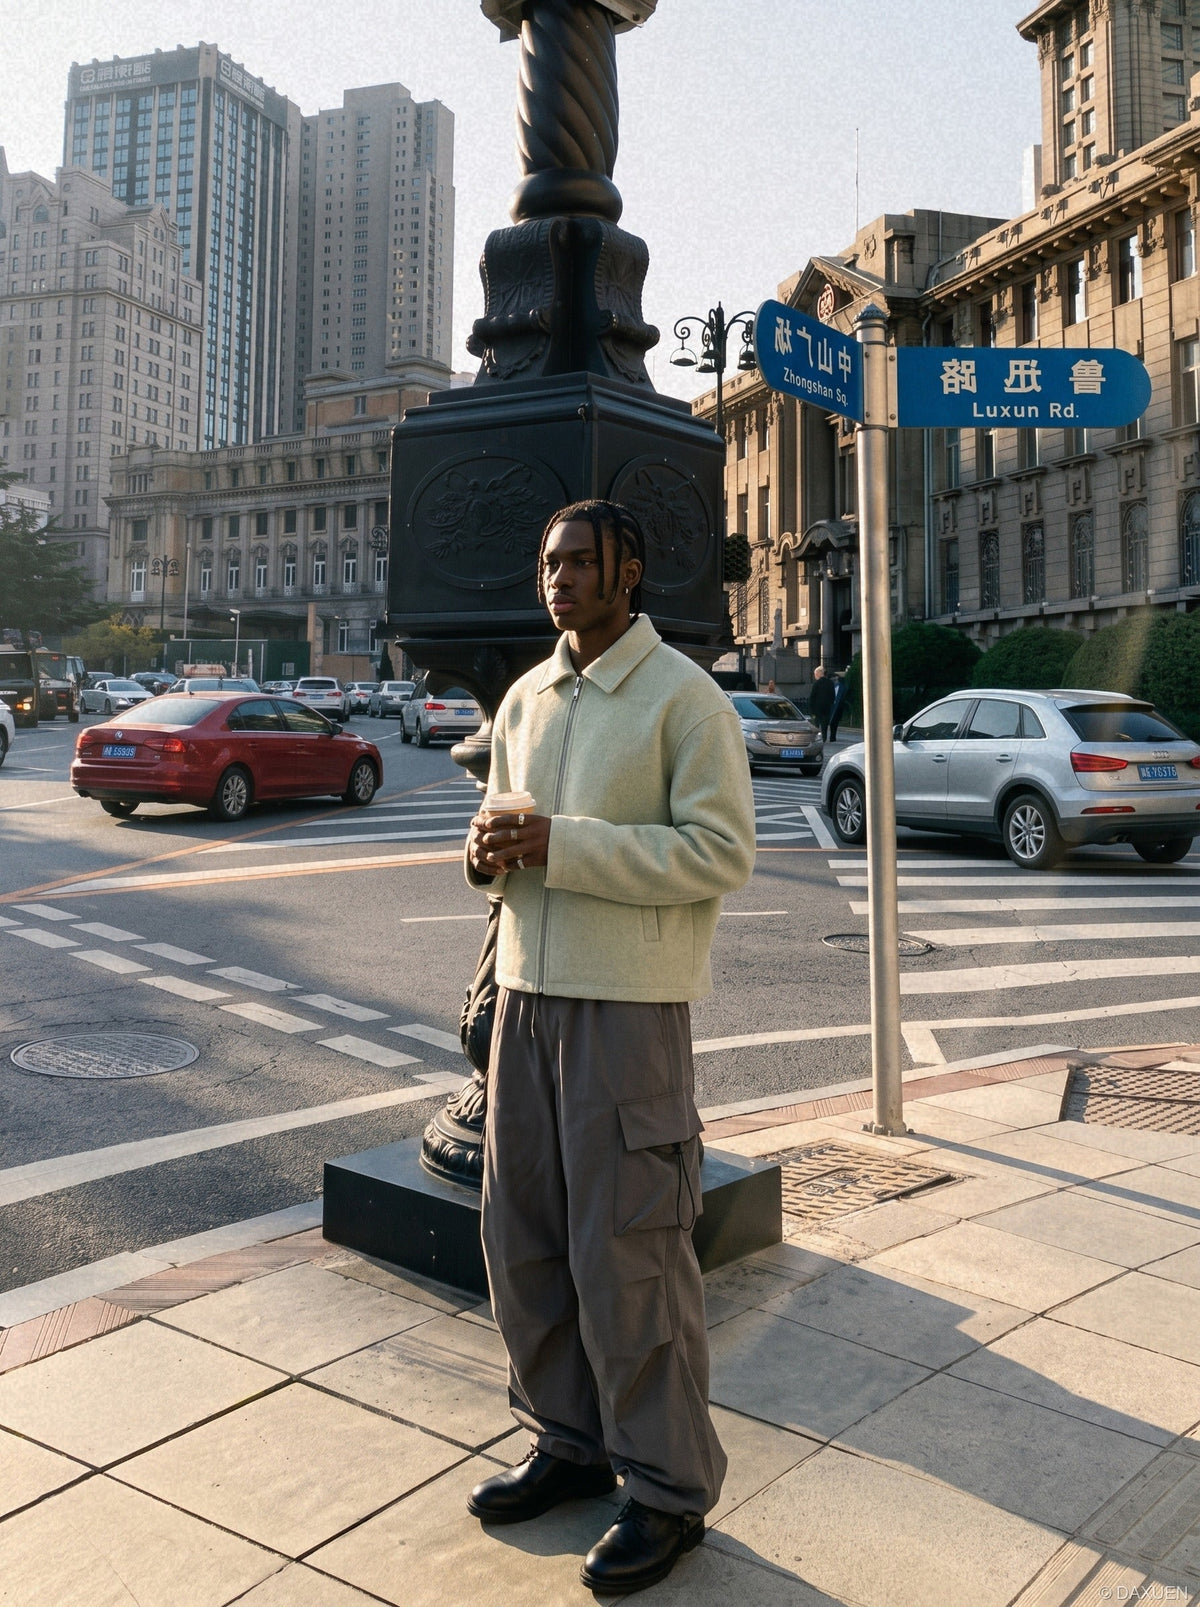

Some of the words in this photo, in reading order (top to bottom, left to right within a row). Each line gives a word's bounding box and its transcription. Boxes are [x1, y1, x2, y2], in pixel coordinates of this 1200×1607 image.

[783, 366, 833, 399] Zhongshan
[836, 388, 849, 407] Sq.
[972, 402, 1039, 418] Luxun
[1049, 402, 1079, 418] Rd.
